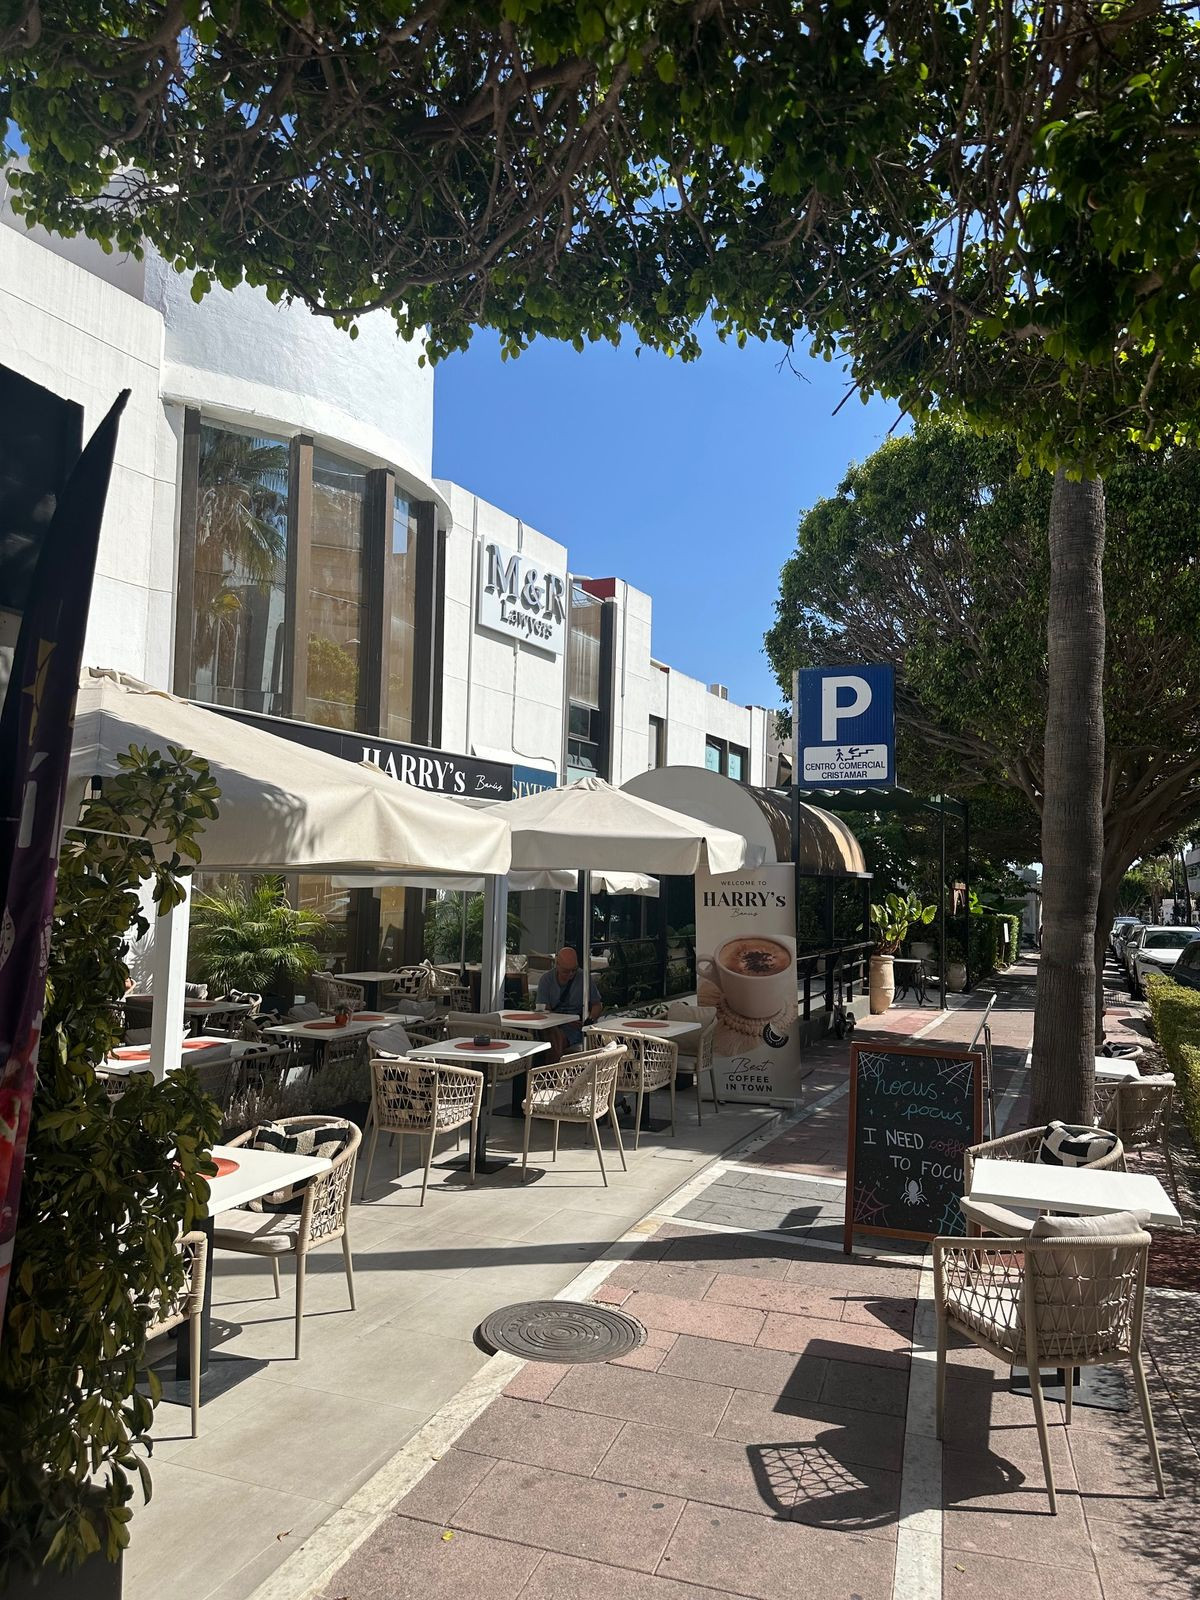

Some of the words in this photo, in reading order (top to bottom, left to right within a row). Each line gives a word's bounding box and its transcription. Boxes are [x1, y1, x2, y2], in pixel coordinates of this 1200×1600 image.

[484, 543, 566, 624] M&R
[500, 599, 553, 640] Lawyers
[822, 675, 872, 741] P
[805, 762, 836, 771] CENTRO
[839, 760, 886, 770] COMERCIAL
[821, 770, 868, 780] CRISTAMAR
[723, 1057, 775, 1075] Best
[725, 1083, 737, 1091] IN
[742, 1084, 773, 1093] TOWN
[728, 1074, 769, 1083] COFFEE
[900, 1103, 963, 1126] pocus
[863, 1127, 877, 1145] I
[886, 1129, 924, 1151] NEED
[889, 1155, 911, 1171] TO
[921, 1160, 964, 1183] FOCU
